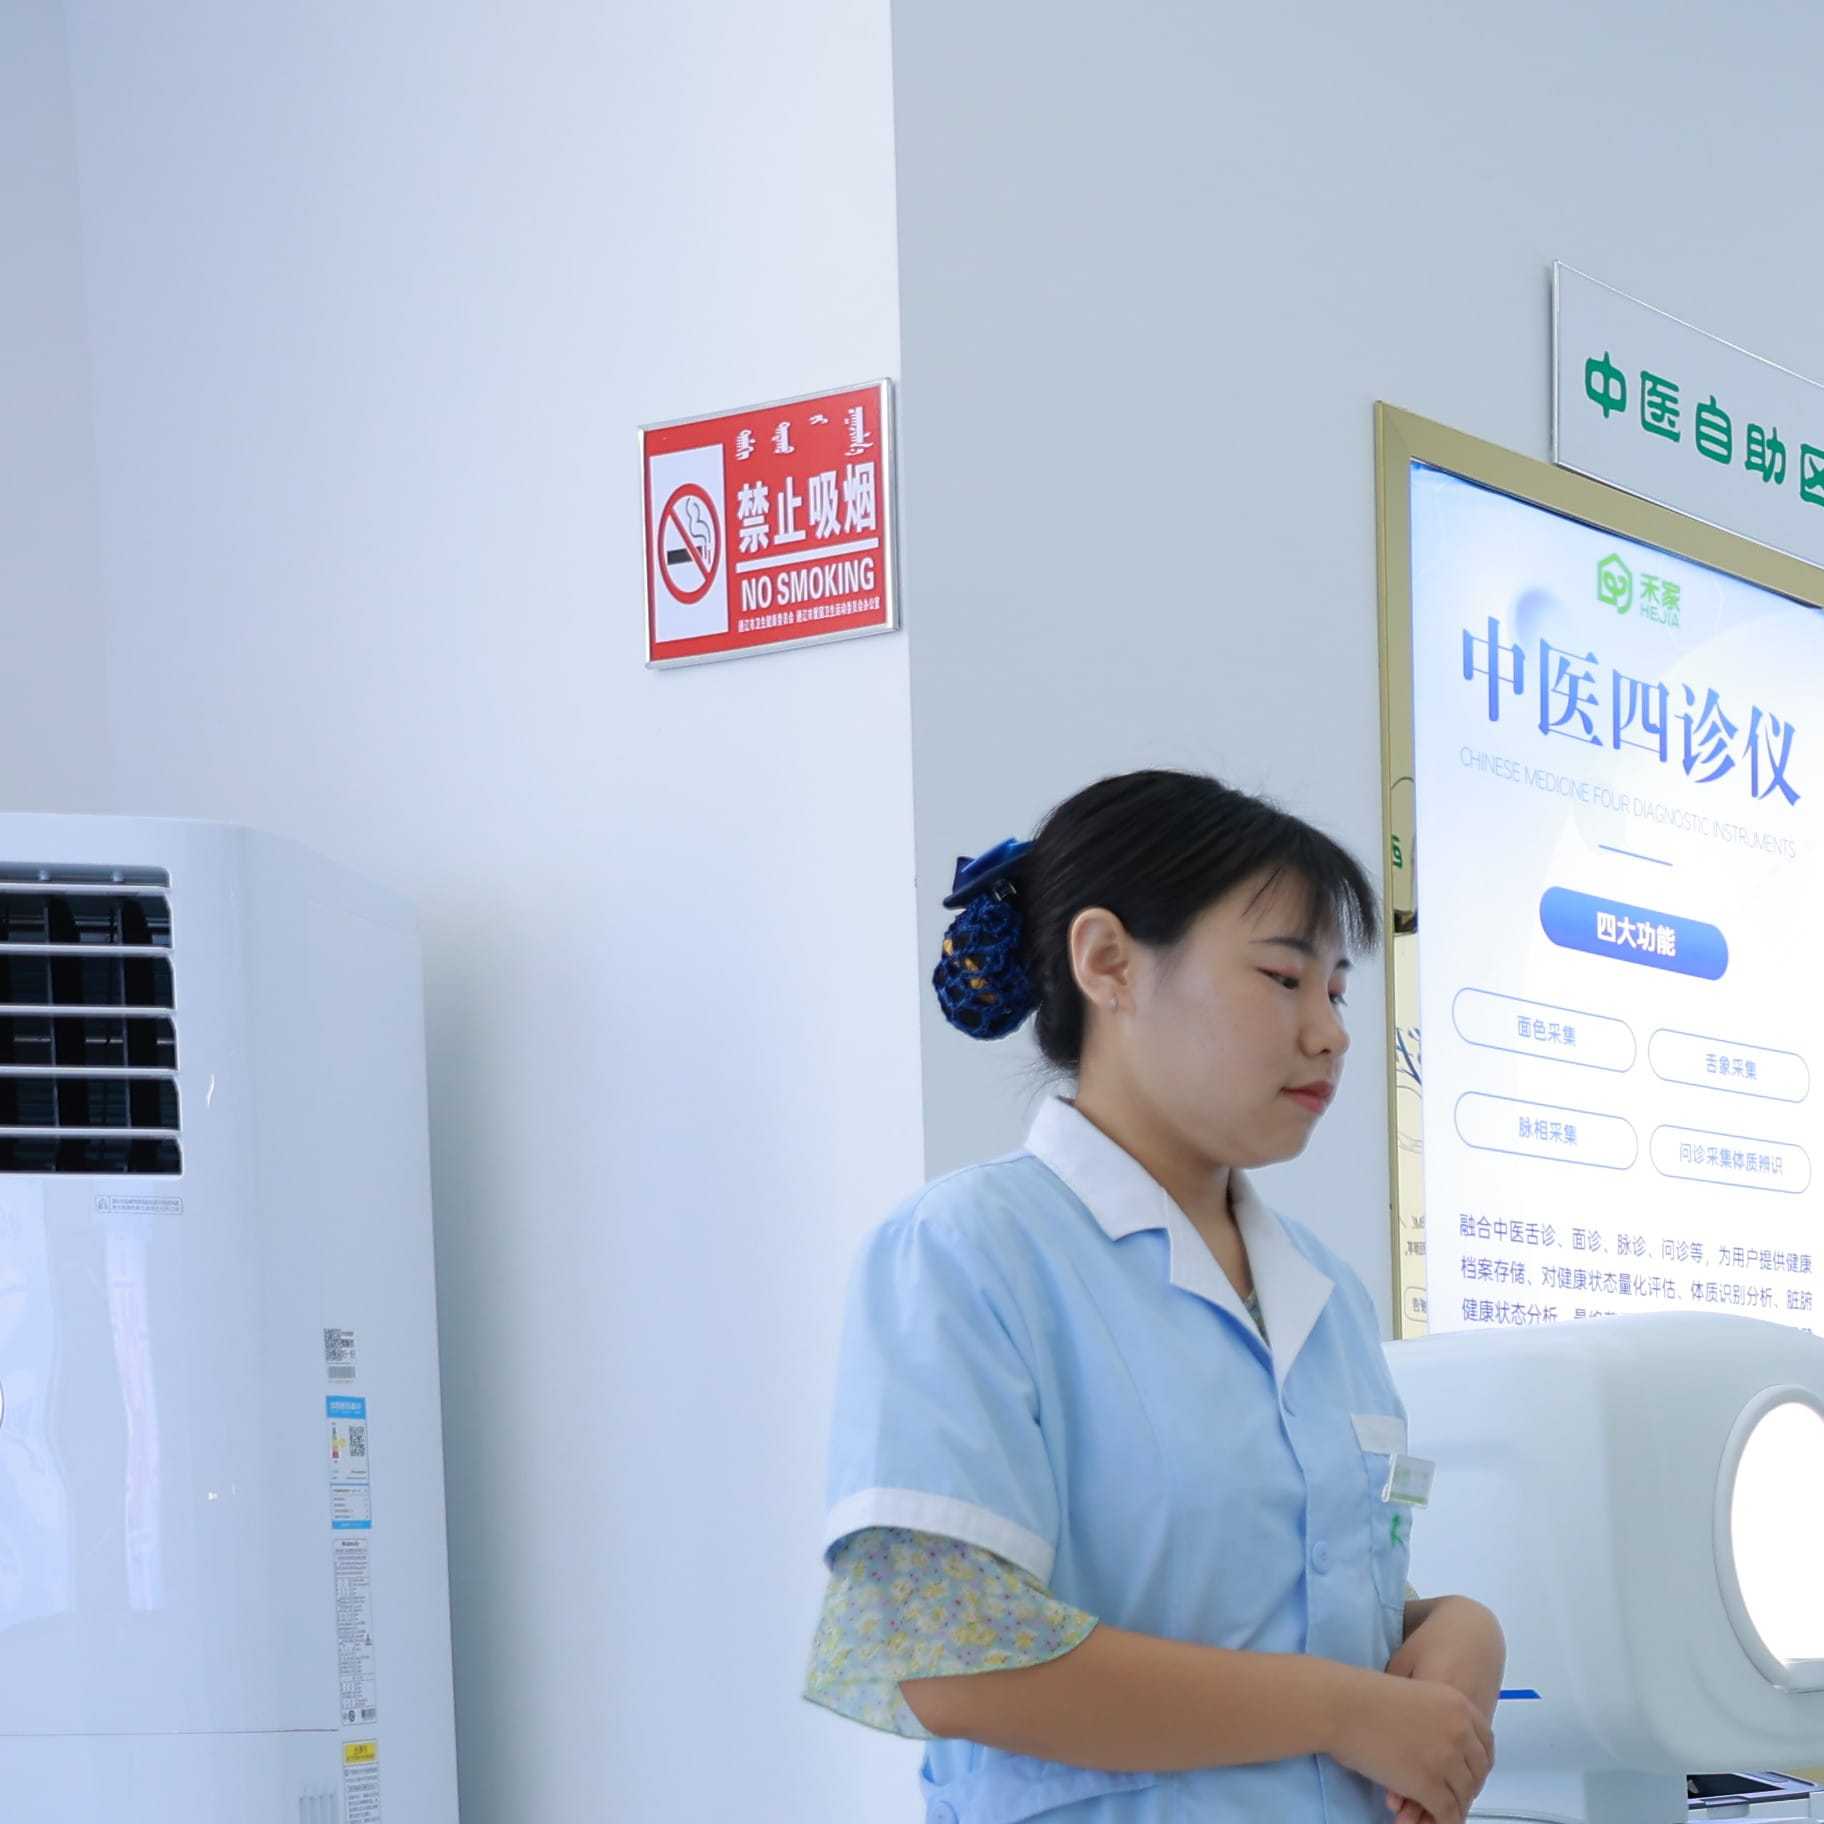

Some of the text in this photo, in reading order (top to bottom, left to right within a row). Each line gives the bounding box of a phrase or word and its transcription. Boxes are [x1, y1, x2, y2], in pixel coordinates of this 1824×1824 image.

[736, 461, 877, 554] 禁止吸烟
[741, 575, 773, 612] NO
[777, 557, 875, 605] SMOKING
[1640, 573, 1681, 612] 禾家
[1640, 605, 1681, 629] HEJIA
[1461, 616, 1801, 807] 中医四诊仪
[1459, 746, 1521, 783] CHINESE
[1524, 766, 1590, 804] MEDICINE
[1593, 786, 1630, 813] FOUR
[1596, 911, 1676, 957] 四大功能
[1516, 1015, 1577, 1048] 面色采集
[1705, 1053, 1758, 1081] 舌象采集
[1679, 1142, 1784, 1176] 问诊采集体质辨识
